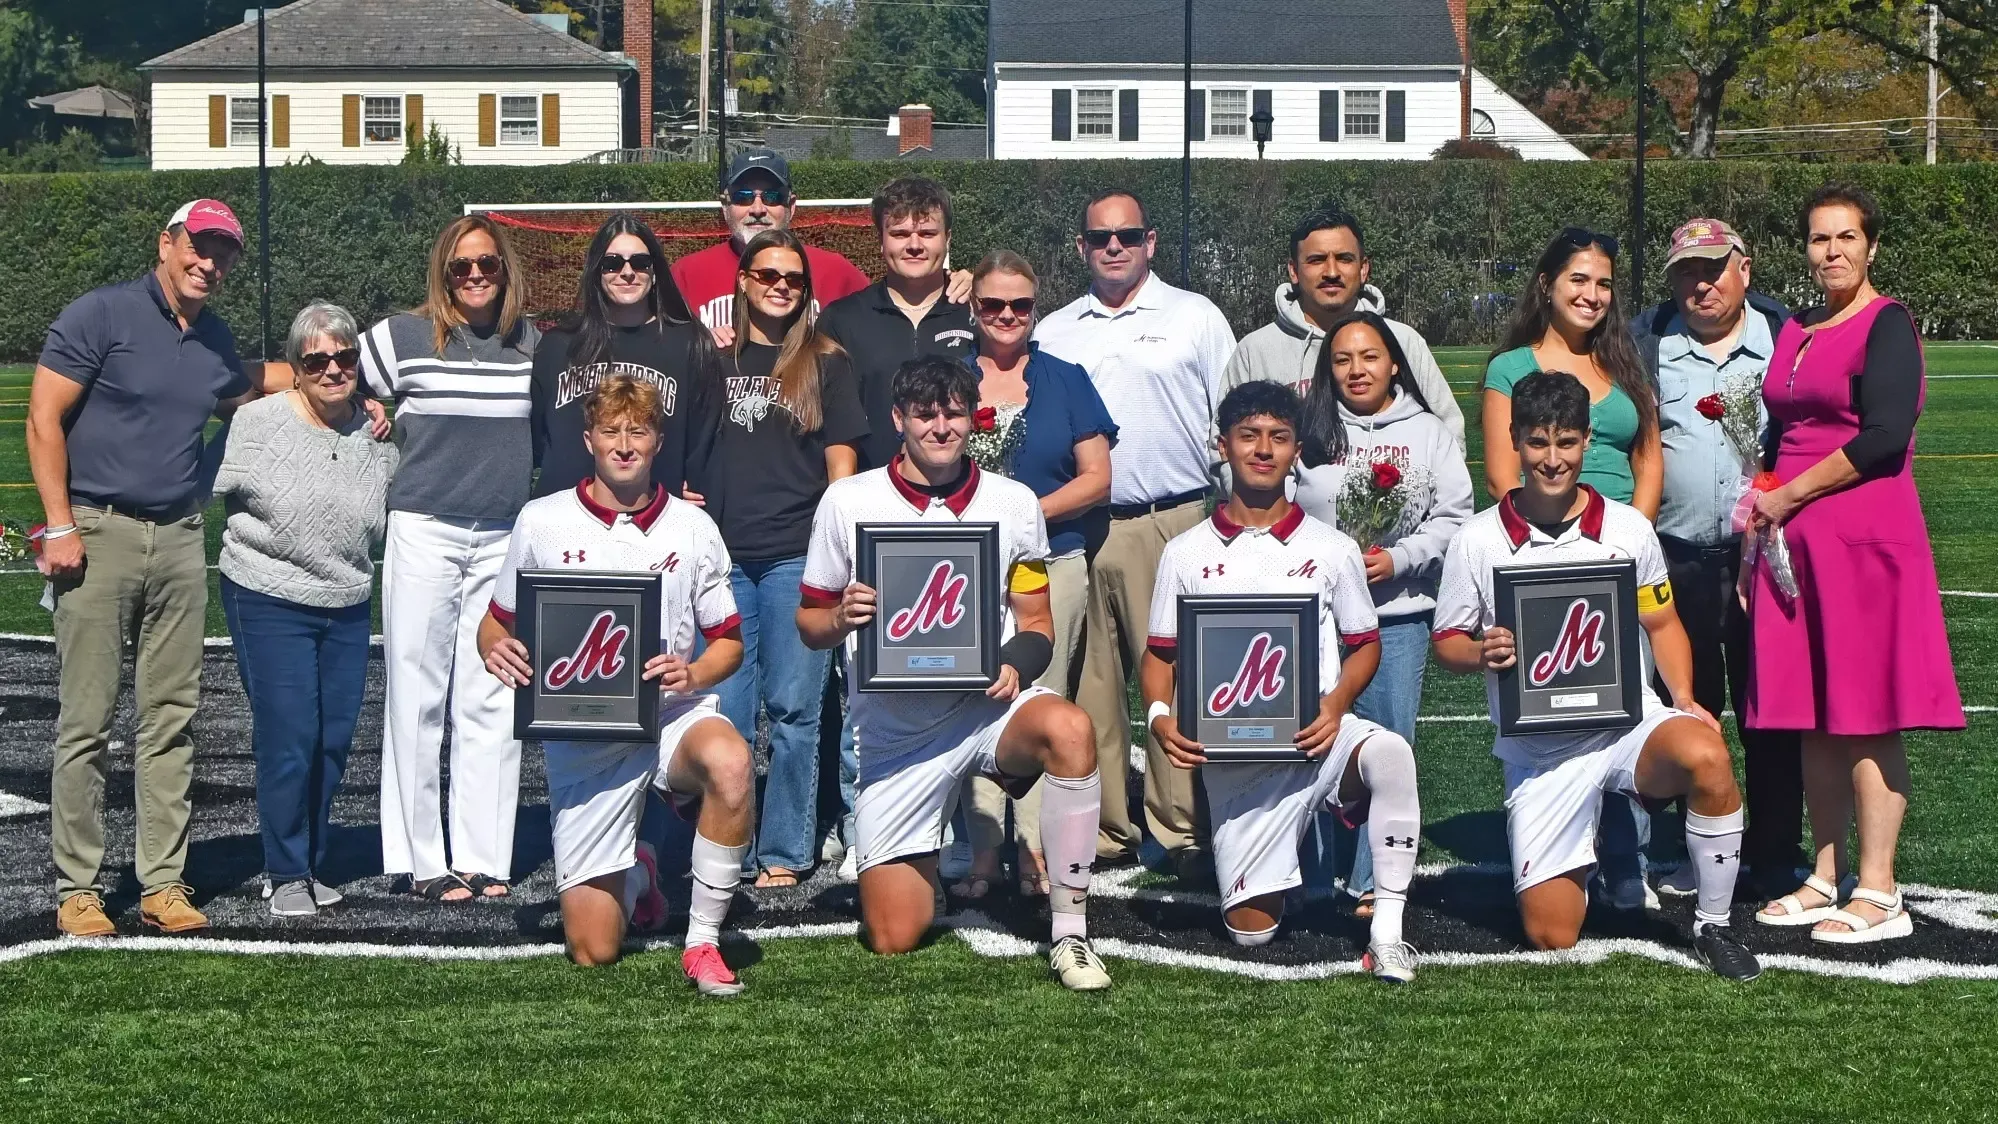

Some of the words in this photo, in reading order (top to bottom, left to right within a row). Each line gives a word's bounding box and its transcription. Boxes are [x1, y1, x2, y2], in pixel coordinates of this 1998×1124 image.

[650, 552, 680, 573] M
[886, 559, 968, 643] M
[1287, 559, 1318, 579] M
[1653, 582, 1671, 605] C
[544, 609, 630, 691] M
[1207, 631, 1287, 718] M
[1528, 597, 1606, 687] M
